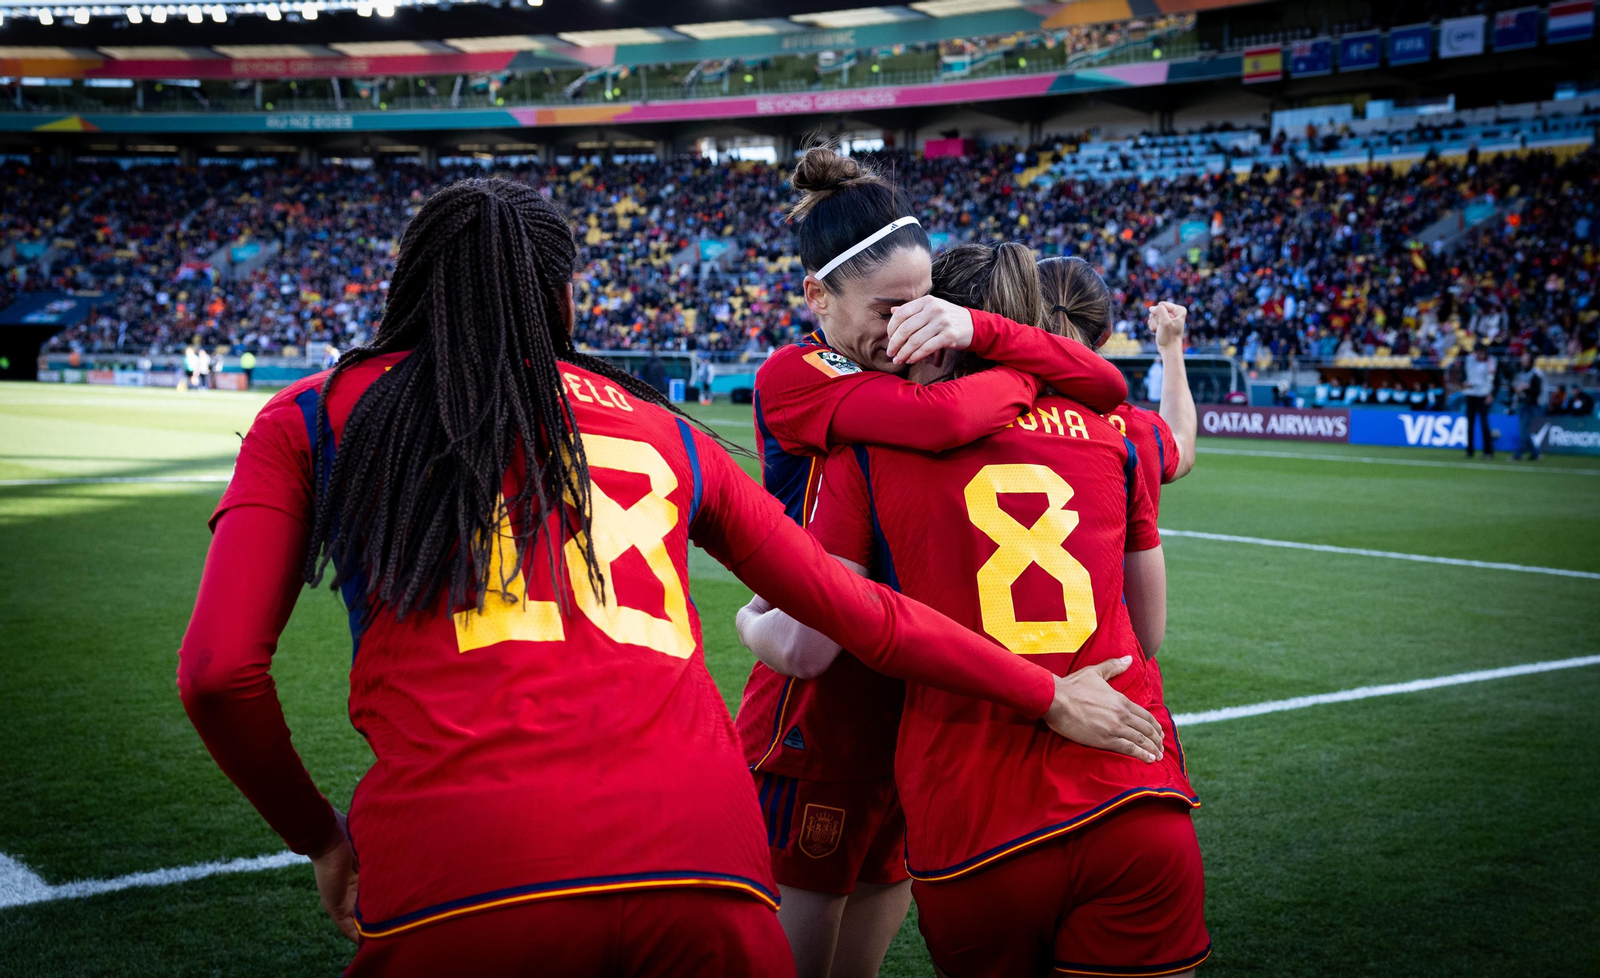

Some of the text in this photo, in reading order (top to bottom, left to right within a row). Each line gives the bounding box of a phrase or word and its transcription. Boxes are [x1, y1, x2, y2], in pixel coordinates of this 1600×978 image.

[756, 92, 896, 114] BEYOND GREATNESS
[556, 372, 634, 412] ELO
[1005, 407, 1090, 440] ONA
[1203, 411, 1348, 438] QATAR AIRWAYS
[1398, 415, 1469, 448] VISA
[453, 433, 697, 660] 18
[964, 464, 1097, 654] 8
